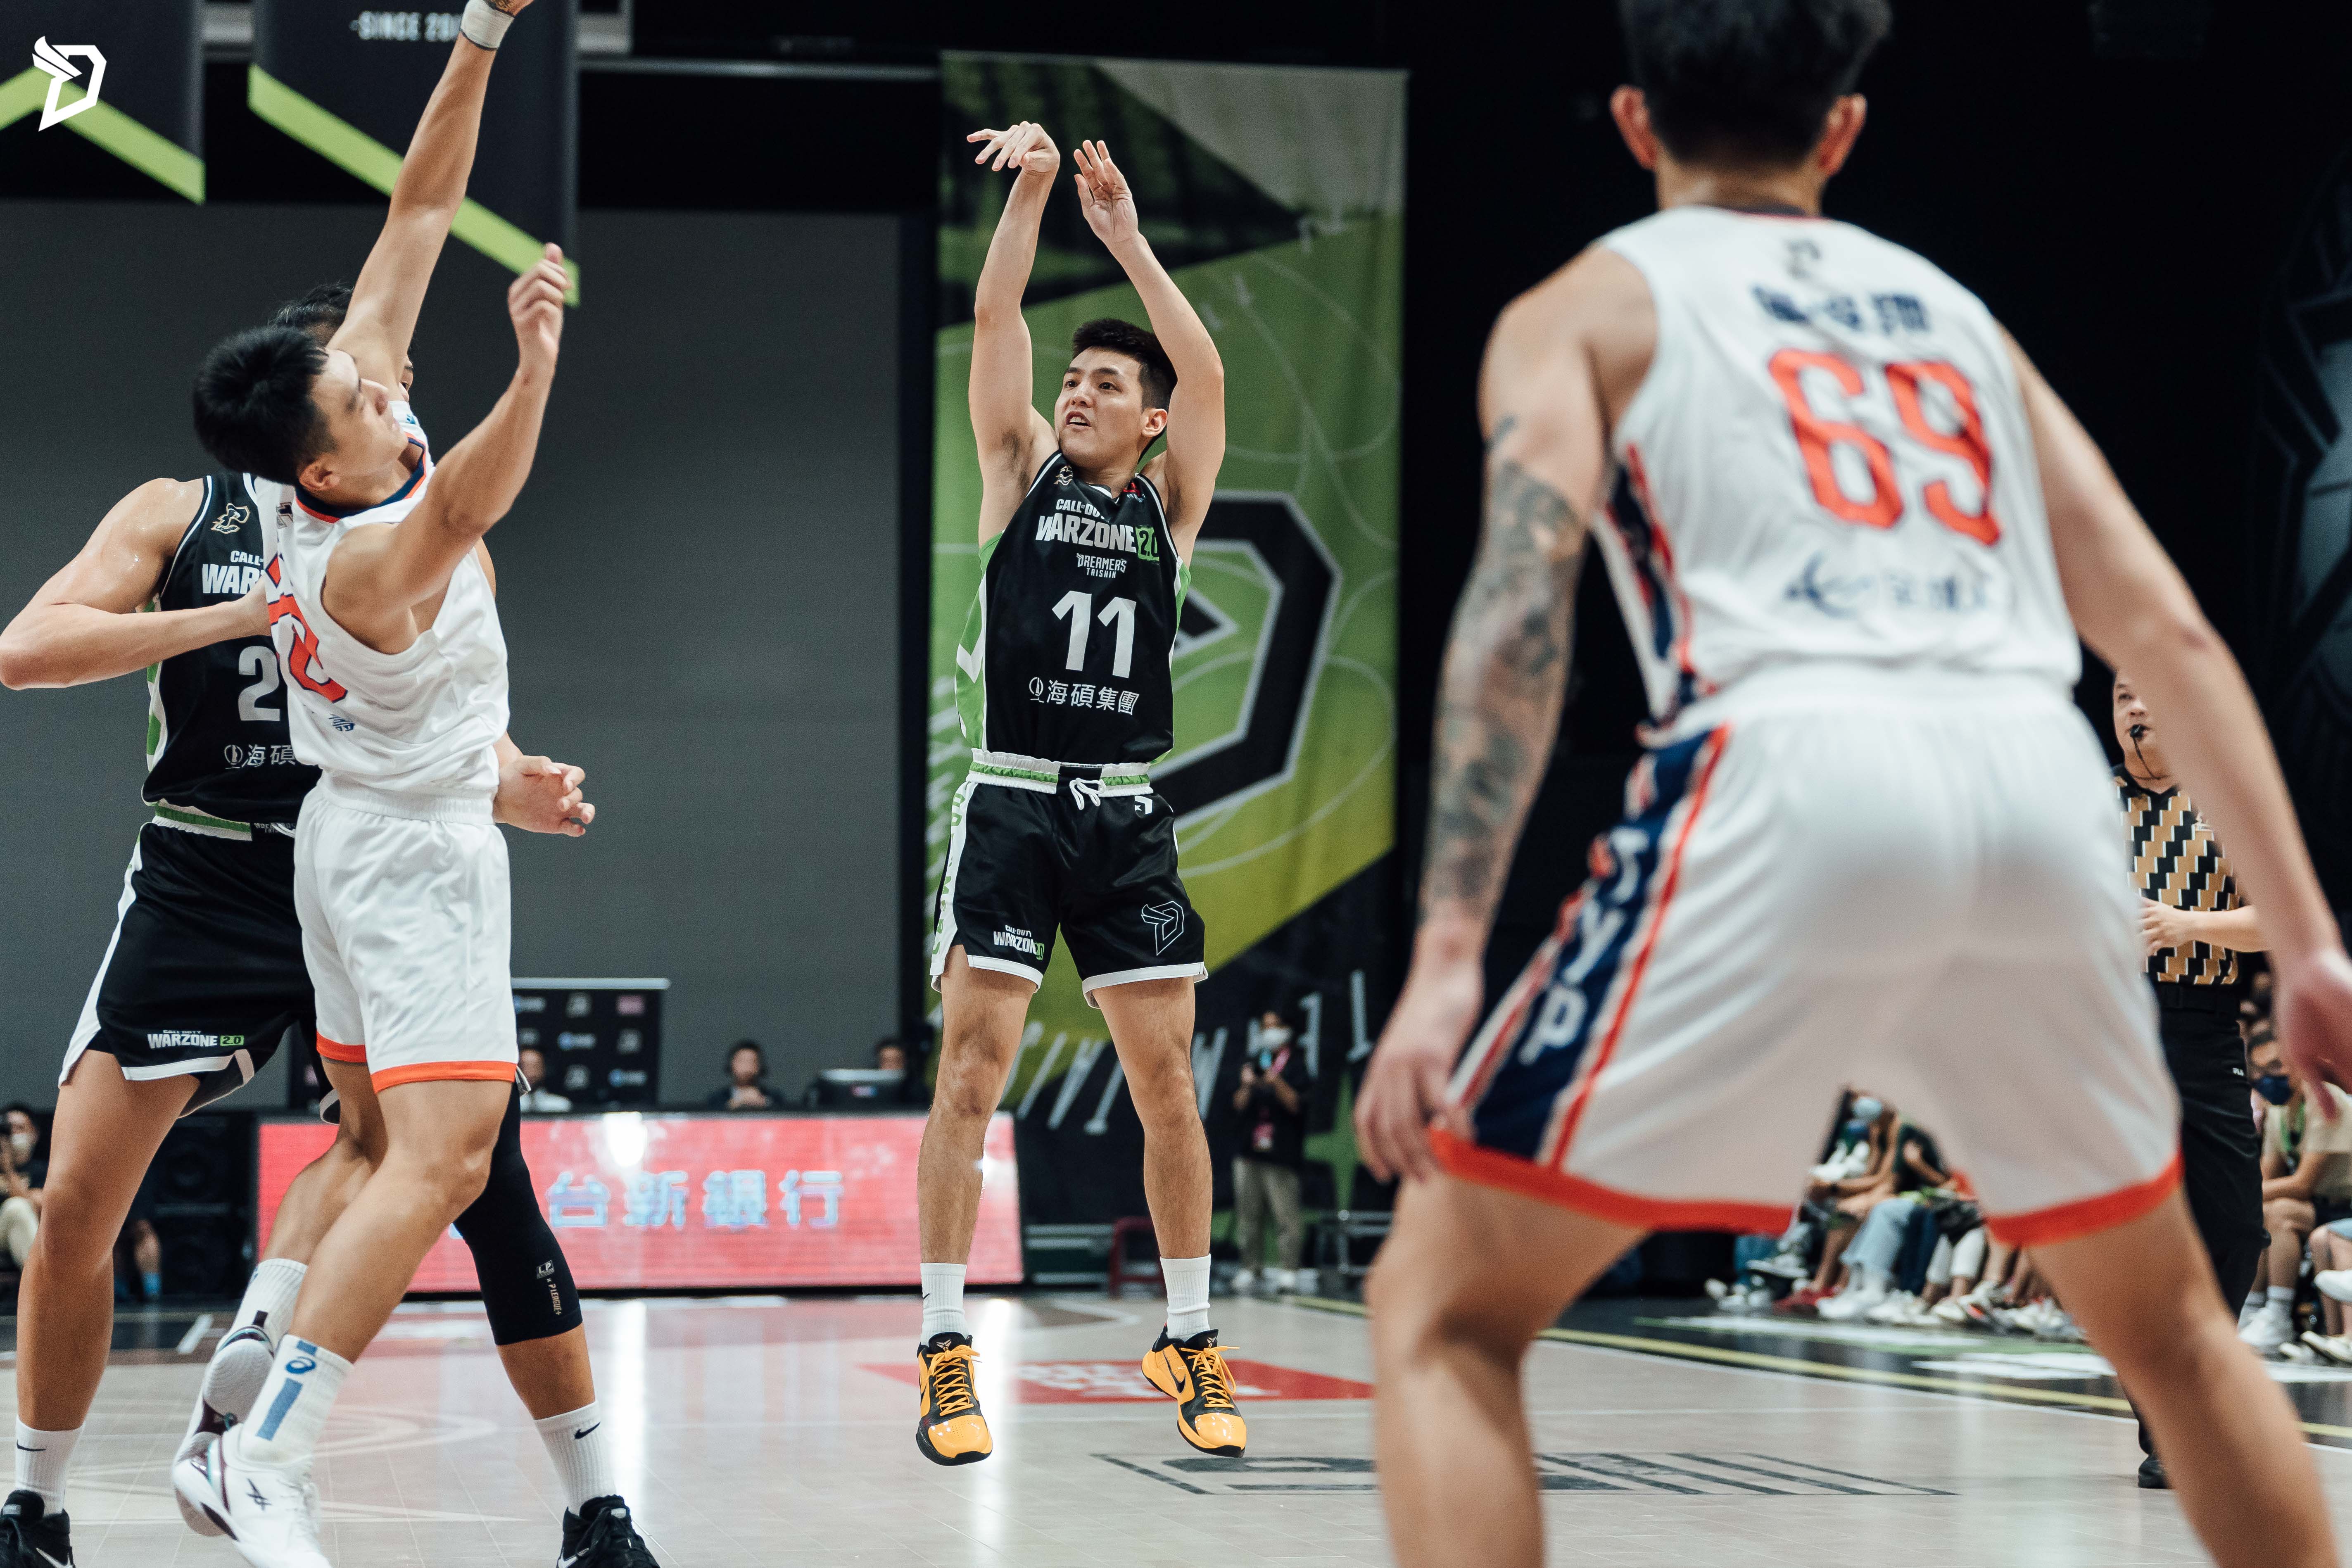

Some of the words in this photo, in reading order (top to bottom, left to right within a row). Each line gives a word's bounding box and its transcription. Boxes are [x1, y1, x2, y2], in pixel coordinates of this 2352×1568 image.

[1767, 347, 2002, 548] 69
[1056, 499, 1082, 513] CALL
[1084, 503, 1109, 523] DU
[1036, 513, 1137, 553] WARZONE
[230, 550, 261, 566] CALL
[1076, 553, 1127, 574] DREAMERS
[1086, 568, 1117, 579] TAISHIN
[1052, 590, 1137, 679] 11
[1046, 679, 1140, 716] 海碩集團
[993, 931, 1036, 955] WARZON
[147, 1033, 218, 1049] WARZONE
[222, 1036, 242, 1045] 2.0
[546, 1169, 844, 1228] 台新銀行
[538, 1262, 552, 1273] LP
